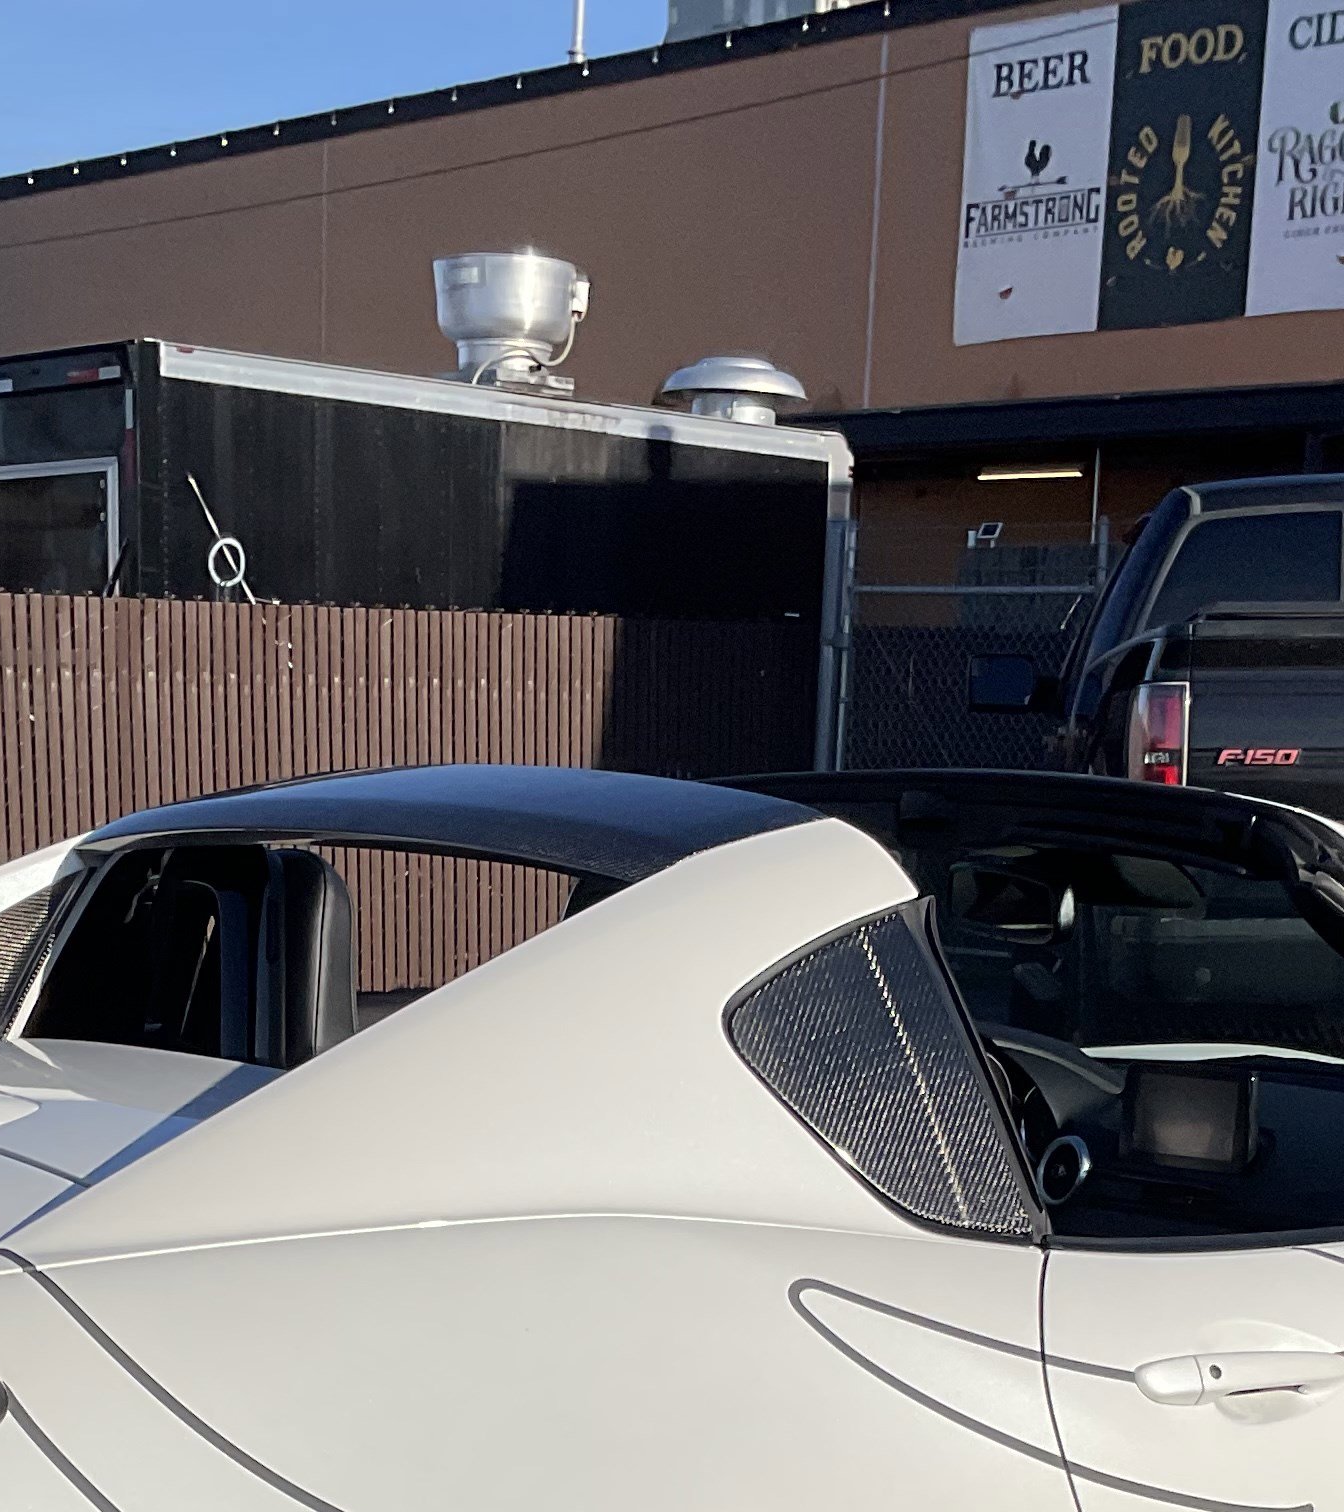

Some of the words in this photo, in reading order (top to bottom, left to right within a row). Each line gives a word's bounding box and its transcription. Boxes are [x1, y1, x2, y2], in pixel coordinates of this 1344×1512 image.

[992, 50, 1090, 98] BEER
[1139, 24, 1244, 74] FOOD
[1116, 125, 1158, 260] ROOTED
[1206, 113, 1244, 249] KITCHEN
[964, 187, 1101, 239] FARMSTRONG
[1217, 748, 1301, 765] F-150
